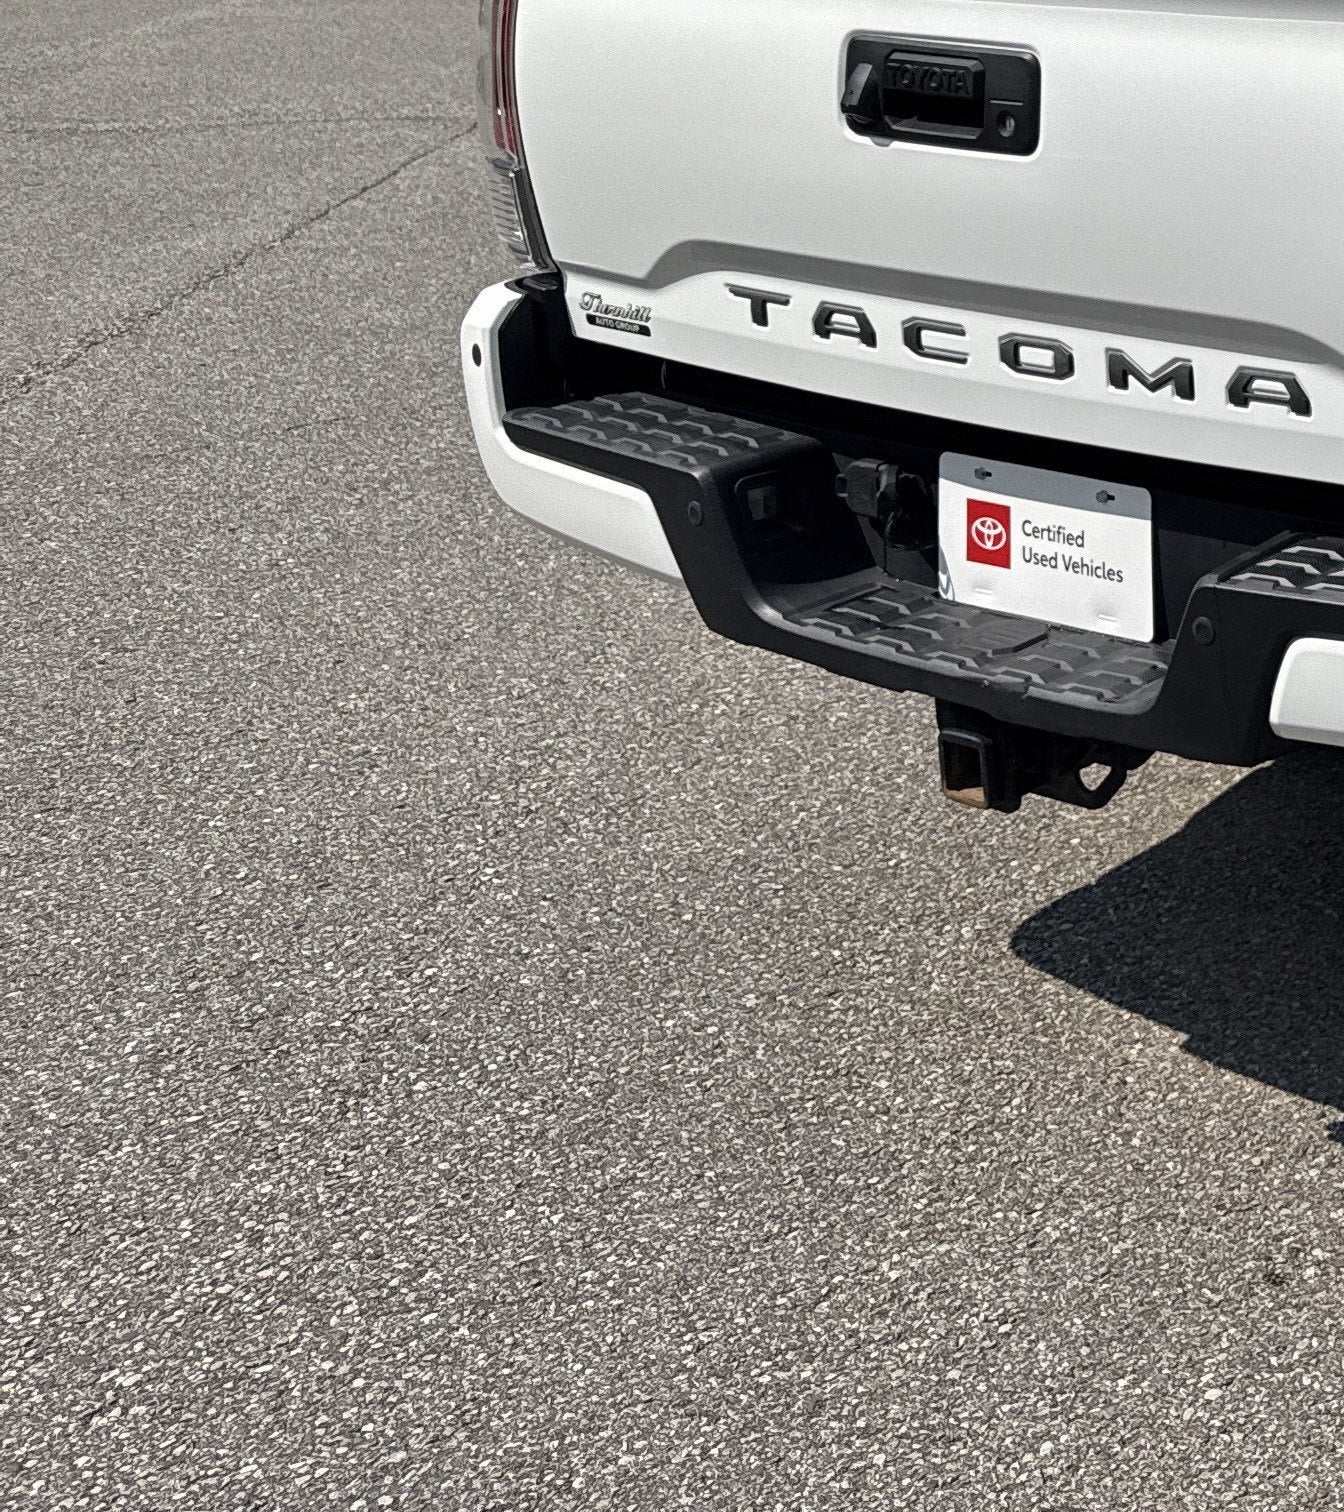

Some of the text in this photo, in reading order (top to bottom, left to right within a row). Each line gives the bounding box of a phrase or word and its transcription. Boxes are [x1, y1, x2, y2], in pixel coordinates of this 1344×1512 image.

[887, 61, 975, 98] TOYOTA
[579, 291, 652, 323] Thornhill
[595, 317, 641, 332] AUTO GROUP
[724, 282, 1313, 419] TACOMA
[1021, 519, 1085, 548] Certified
[1021, 546, 1124, 583] Used Vehicles
